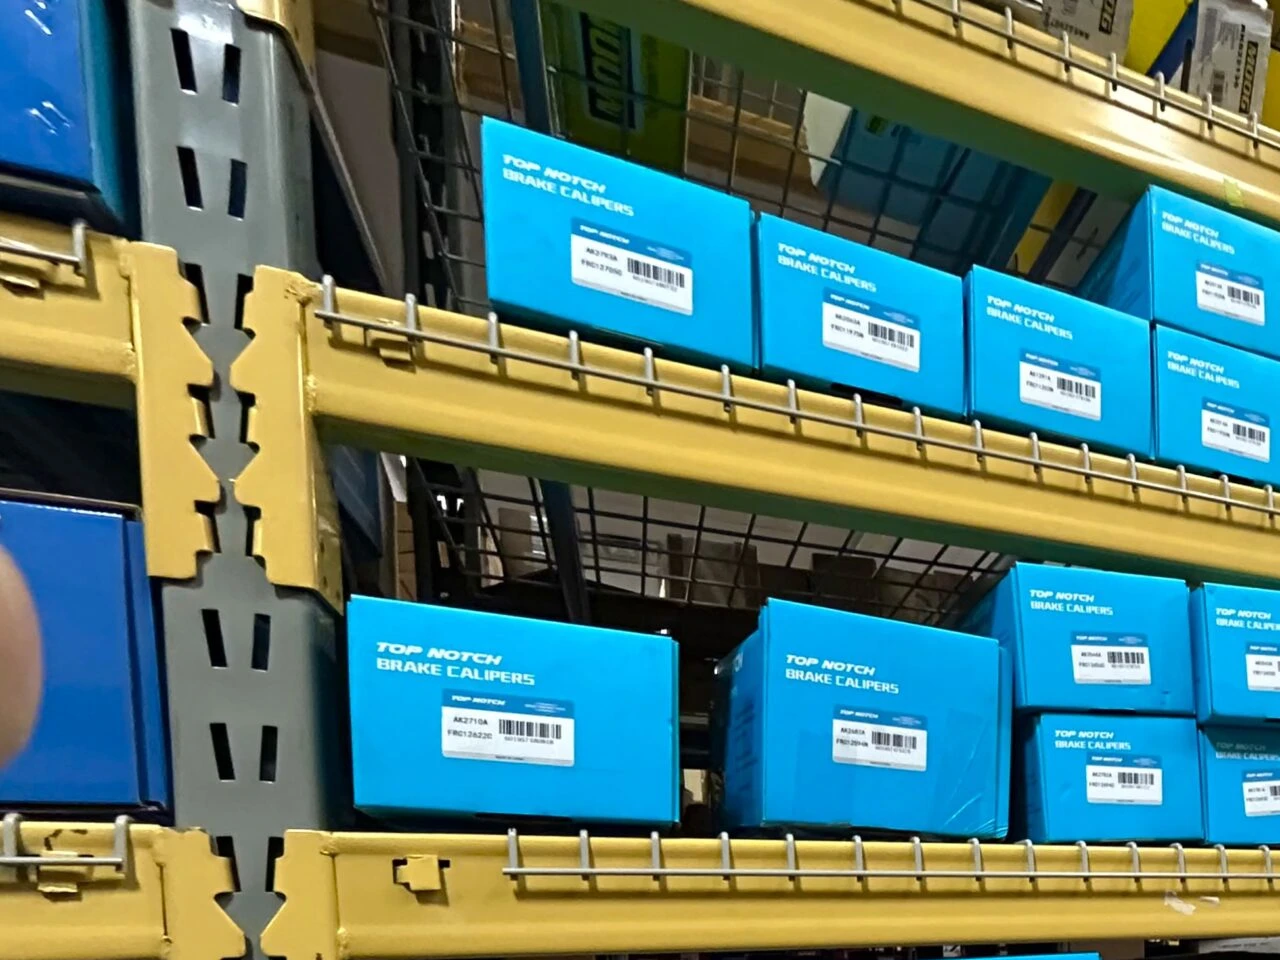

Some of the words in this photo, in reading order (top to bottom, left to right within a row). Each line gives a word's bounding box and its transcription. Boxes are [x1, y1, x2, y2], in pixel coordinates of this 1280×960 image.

[1240, 43, 1258, 112] MOOG
[504, 155, 540, 170] TOP
[544, 168, 606, 193] NOTCH
[503, 168, 556, 192] BRAKE
[560, 186, 634, 216] CALIPERS
[580, 225, 598, 234] TOP
[598, 230, 630, 244] NOTCH
[778, 243, 806, 256] TOP
[808, 253, 855, 273] NOTCH
[778, 255, 817, 274] BRAKE
[821, 268, 876, 292] CALIPERS
[988, 296, 1012, 308] TOP
[1014, 304, 1054, 322] NOTCH
[987, 307, 1022, 324] BRAKE
[1024, 318, 1072, 339] CALIPERS
[1168, 352, 1188, 362] TOP
[1190, 358, 1224, 373] NOTCH
[1168, 361, 1197, 376] BRAKE
[1198, 370, 1239, 388] CALIPERS
[1030, 590, 1053, 598] TOP
[1056, 592, 1094, 602] NOTCH
[1031, 601, 1063, 611] BRAKE
[1067, 604, 1113, 615] CALIPERS
[1238, 610, 1271, 619] NOTCH
[1216, 618, 1244, 627] BRAKE
[378, 642, 423, 655] TOP
[427, 648, 502, 665] NOTCH
[377, 658, 441, 675] BRAKE
[447, 666, 534, 685] CALIPERS
[787, 655, 818, 666] TOP
[822, 660, 875, 676] NOTCH
[786, 669, 831, 684] BRAKE
[836, 676, 898, 694] CALIPERS
[472, 697, 506, 706] NOTCH
[453, 716, 488, 726] AK2710A
[1055, 740, 1085, 748] BRAKE
